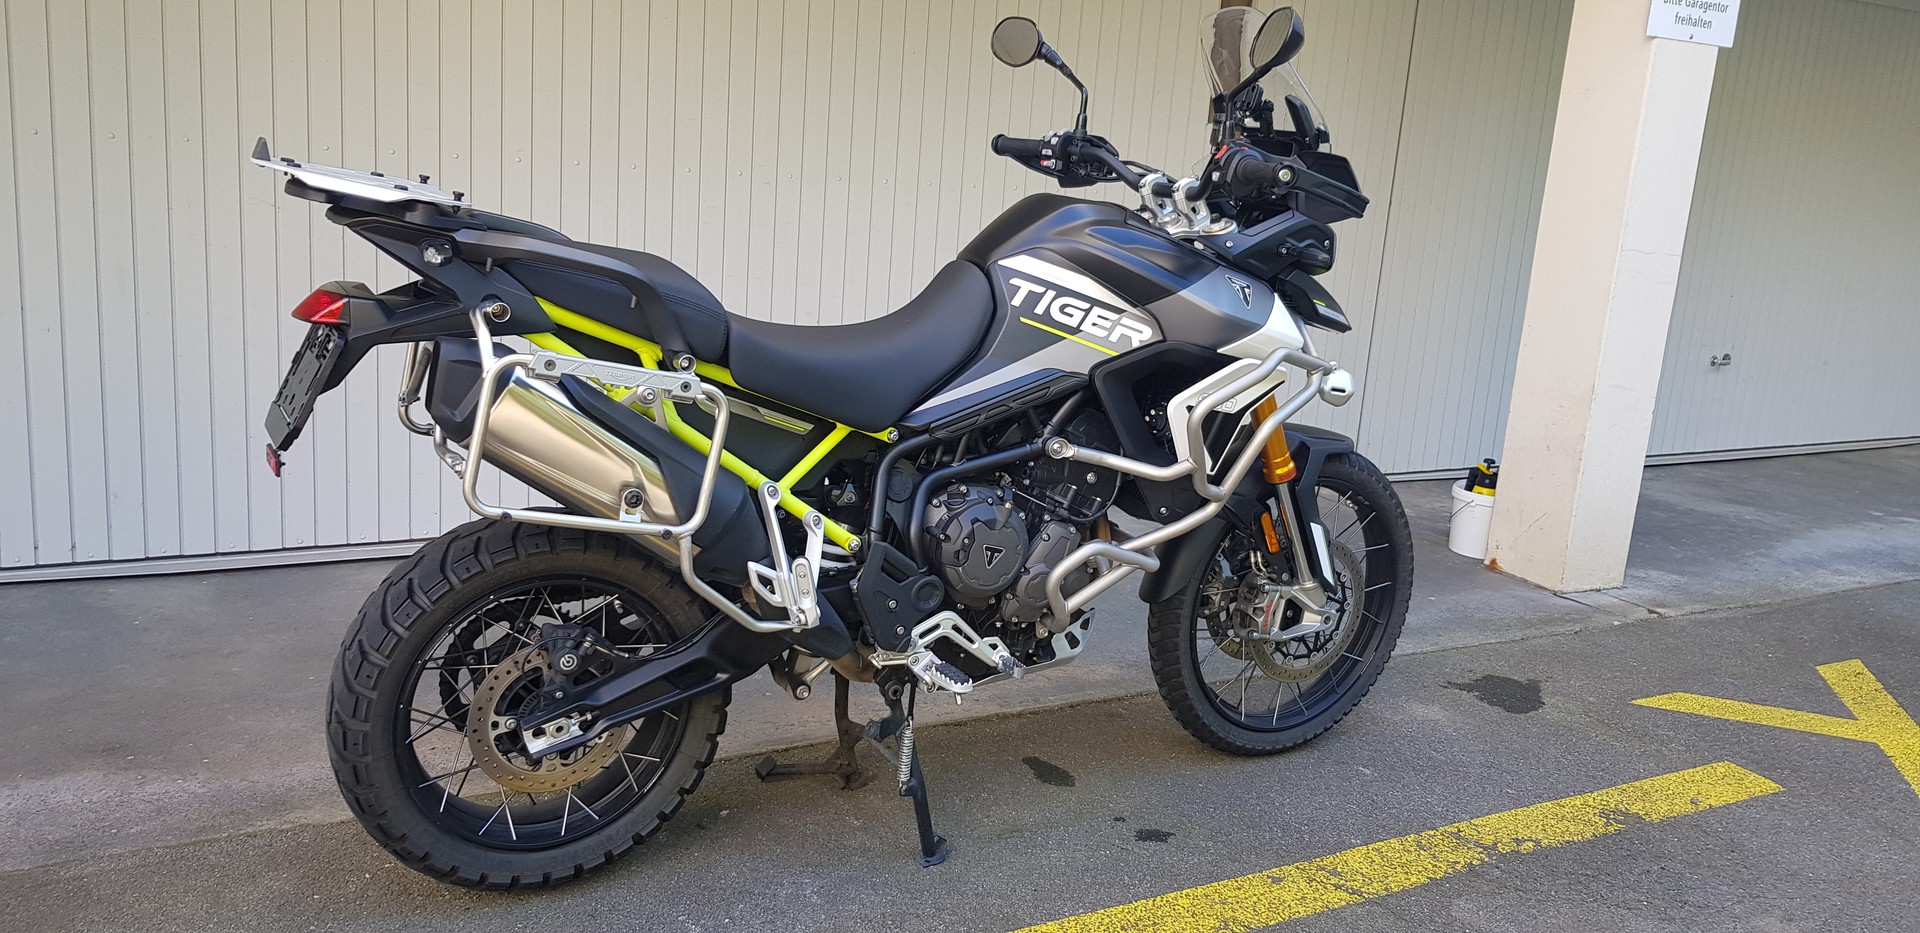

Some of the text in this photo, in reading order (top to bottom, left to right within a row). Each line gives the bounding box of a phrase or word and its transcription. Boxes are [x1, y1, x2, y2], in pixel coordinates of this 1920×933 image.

[1685, 0, 1729, 13] Garagentor
[1674, 11, 1712, 29] freihalten
[1008, 277, 1153, 347] TIGER
